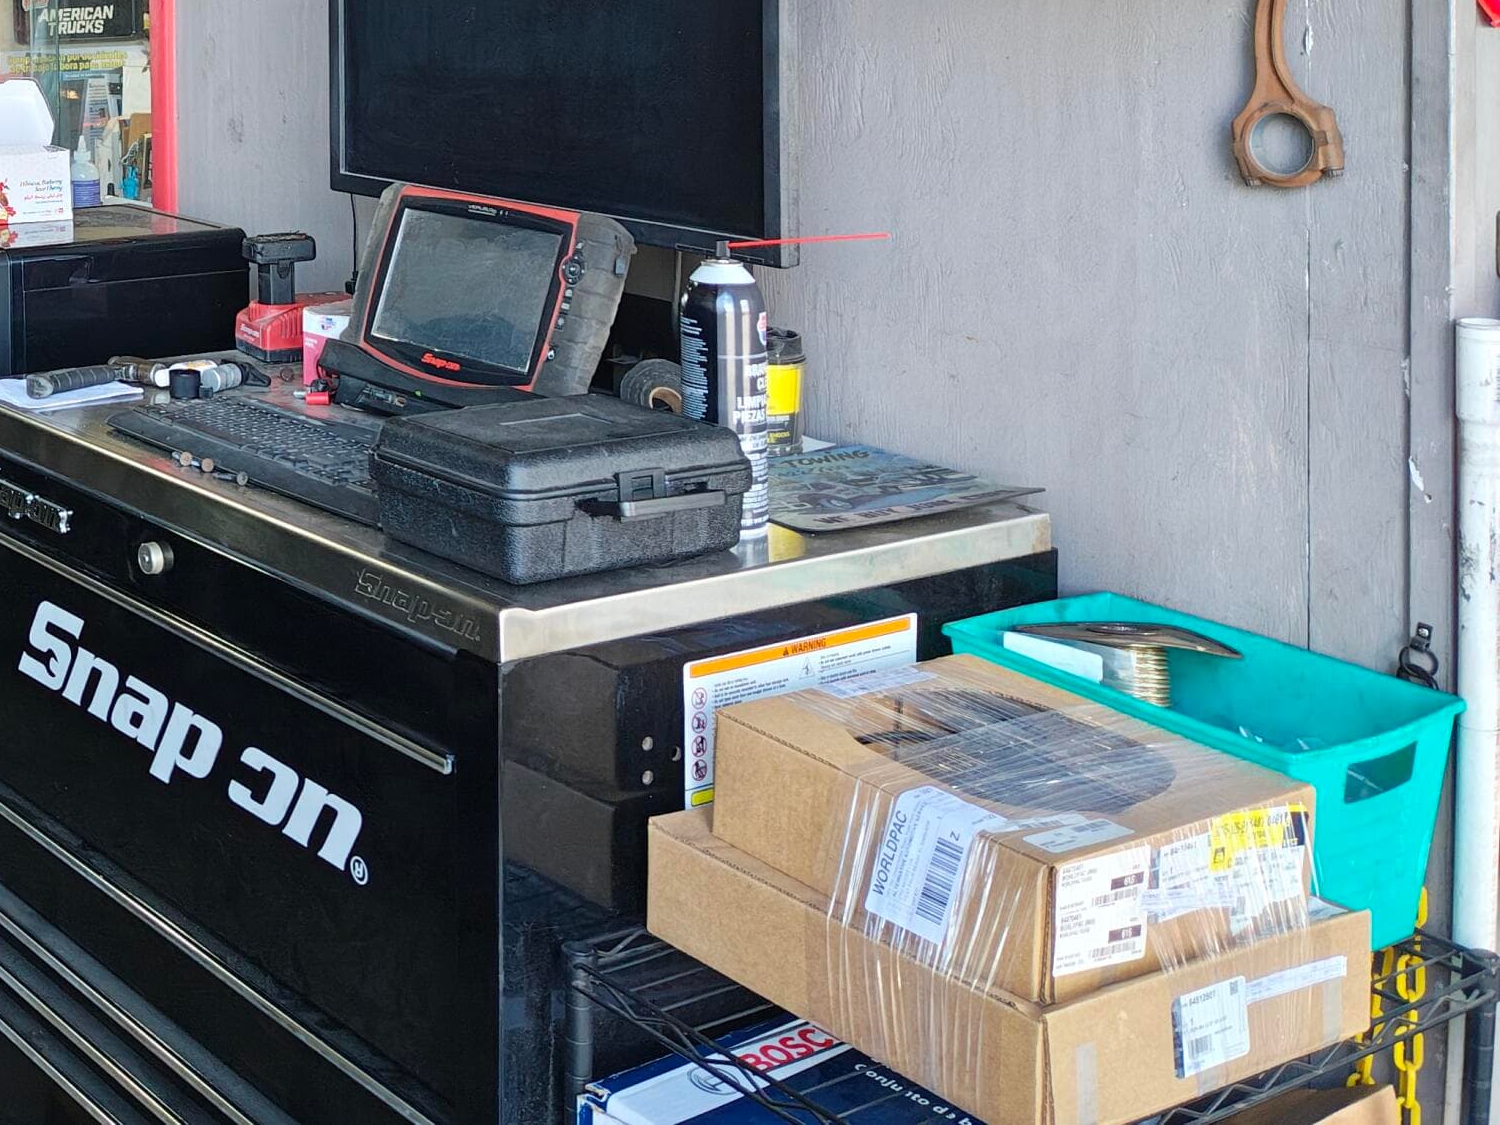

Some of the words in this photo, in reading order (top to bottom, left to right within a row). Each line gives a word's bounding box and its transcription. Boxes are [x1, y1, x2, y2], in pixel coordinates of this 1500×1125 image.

[38, 4, 114, 23] AMERICAN
[48, 19, 104, 36] TRUCKS
[791, 638, 828, 655] WARNING
[872, 810, 907, 896] WORLDPAC
[737, 1028, 835, 1072] BOSC
